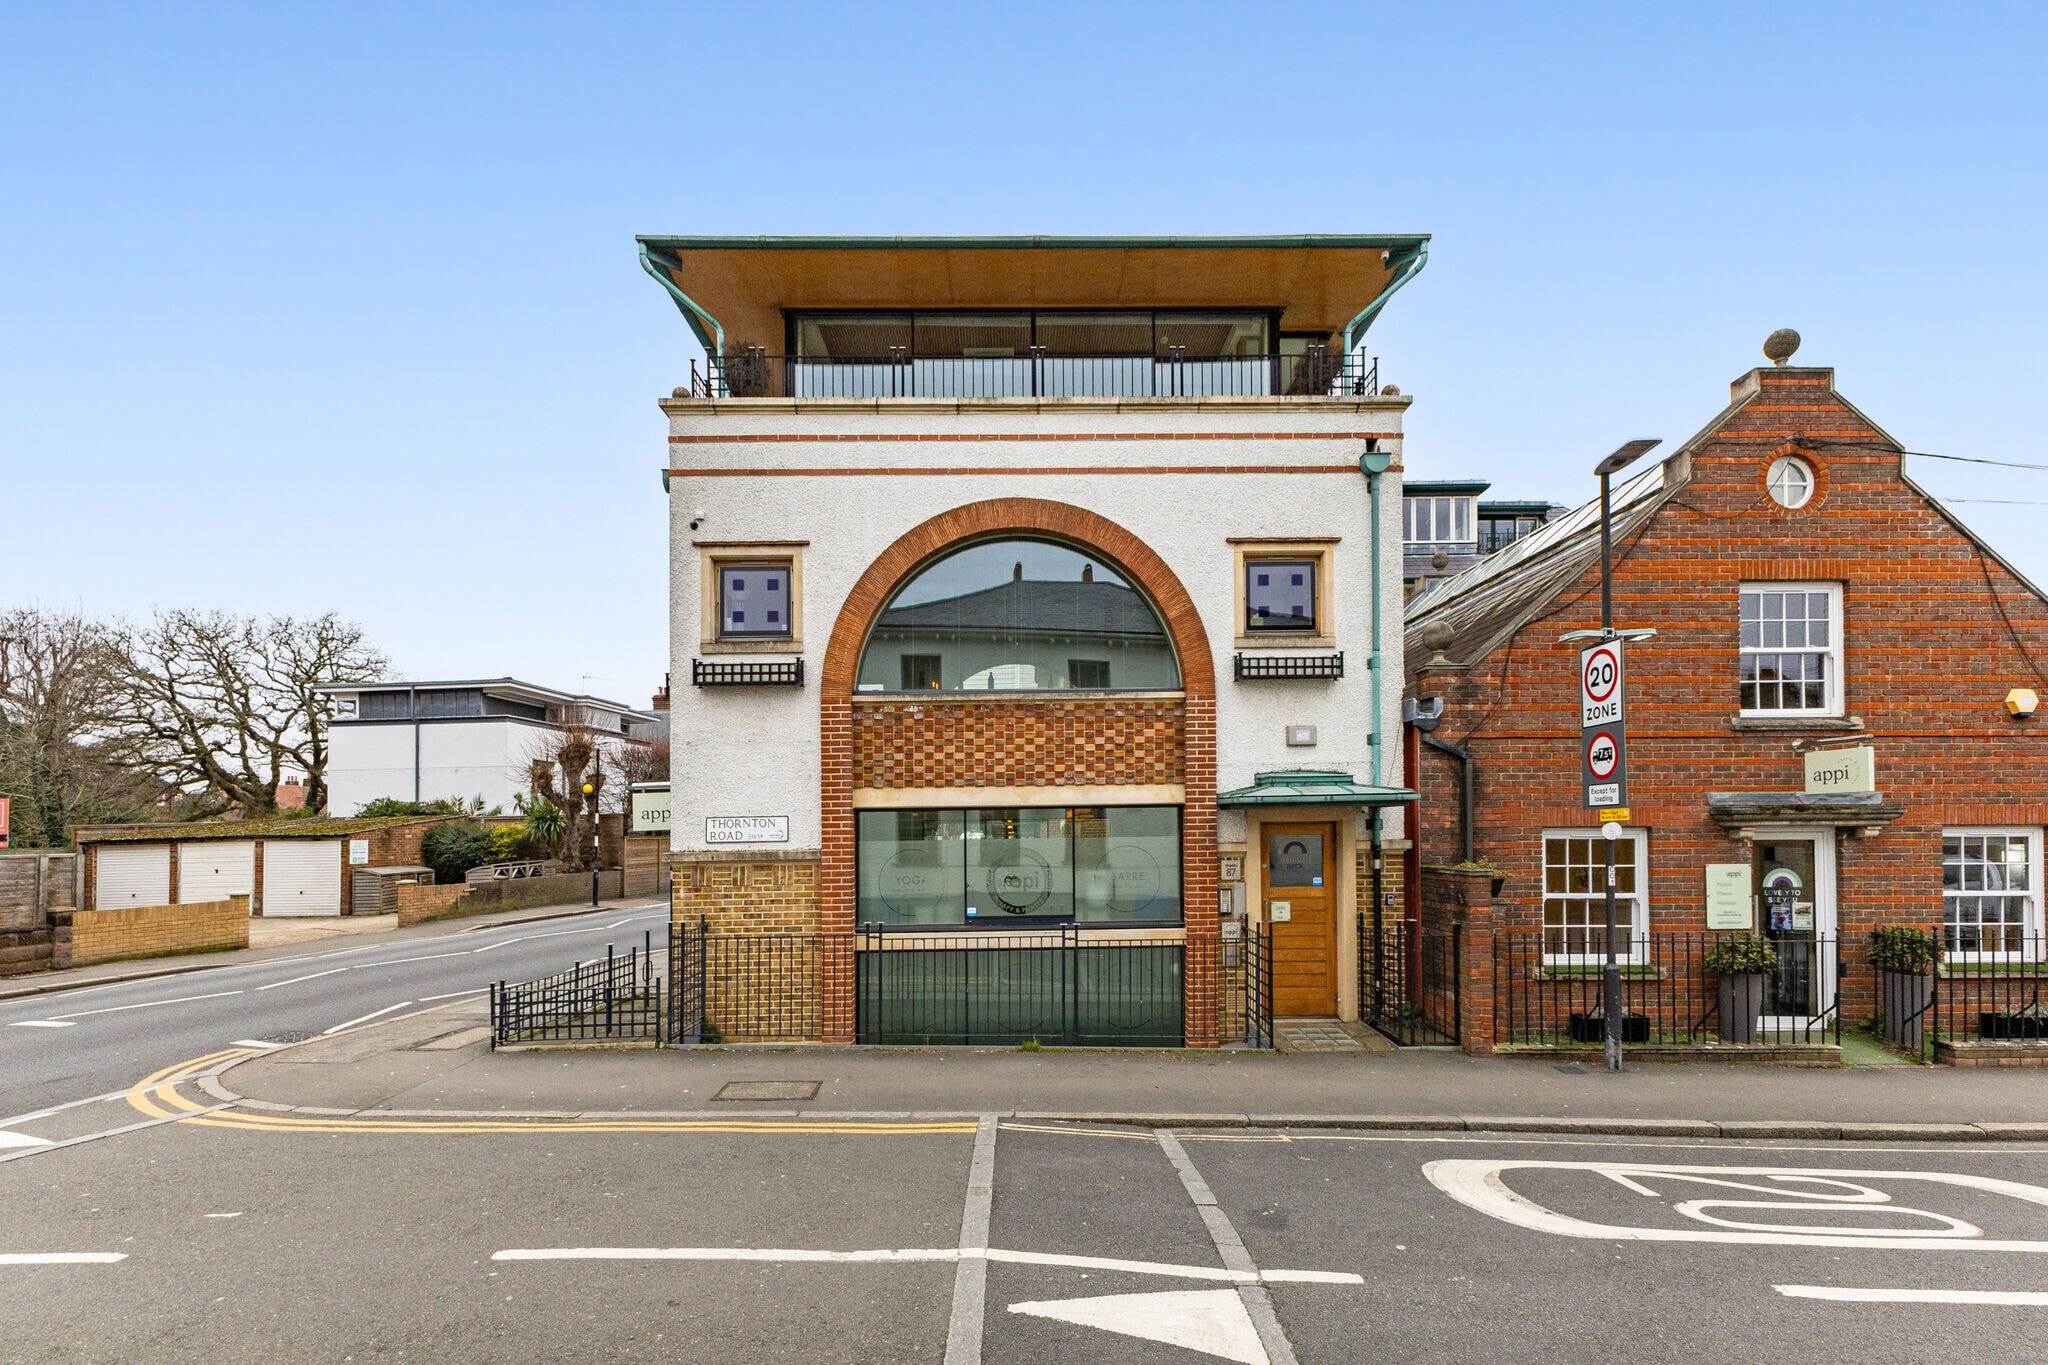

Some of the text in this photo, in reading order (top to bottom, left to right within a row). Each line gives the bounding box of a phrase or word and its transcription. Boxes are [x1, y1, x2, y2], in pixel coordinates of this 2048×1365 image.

[1590, 663, 1613, 687] 20
[1586, 702, 1617, 720] ZONE
[1813, 764, 1849, 785] appi
[1591, 787, 1608, 795] Except
[710, 818, 776, 828] THORNTON
[710, 831, 743, 840] ROAD
[1226, 868, 1237, 877] 87
